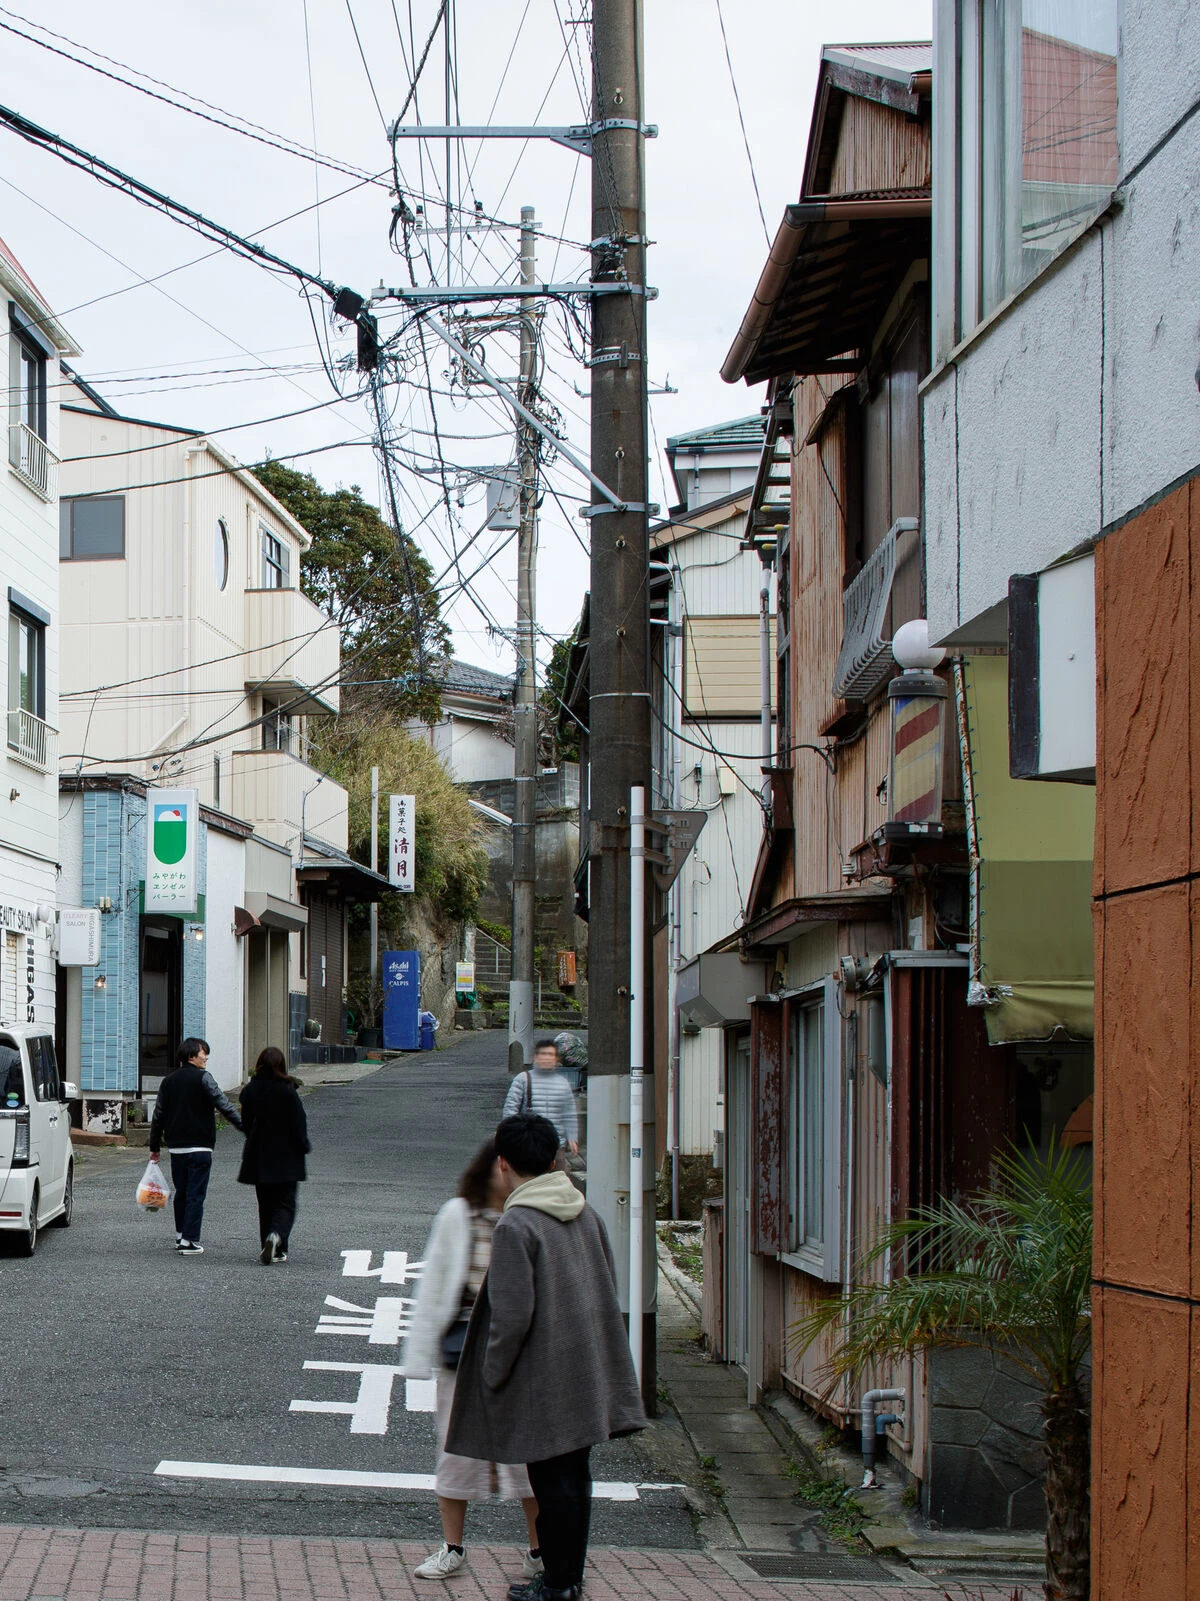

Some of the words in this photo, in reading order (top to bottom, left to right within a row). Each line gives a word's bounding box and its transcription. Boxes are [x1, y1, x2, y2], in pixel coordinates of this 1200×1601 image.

[152, 872, 187, 880] みやがわ
[17, 909, 35, 933] SALON
[88, 912, 96, 962] HIGASHIMURA
[389, 961, 409, 969] Asahi
